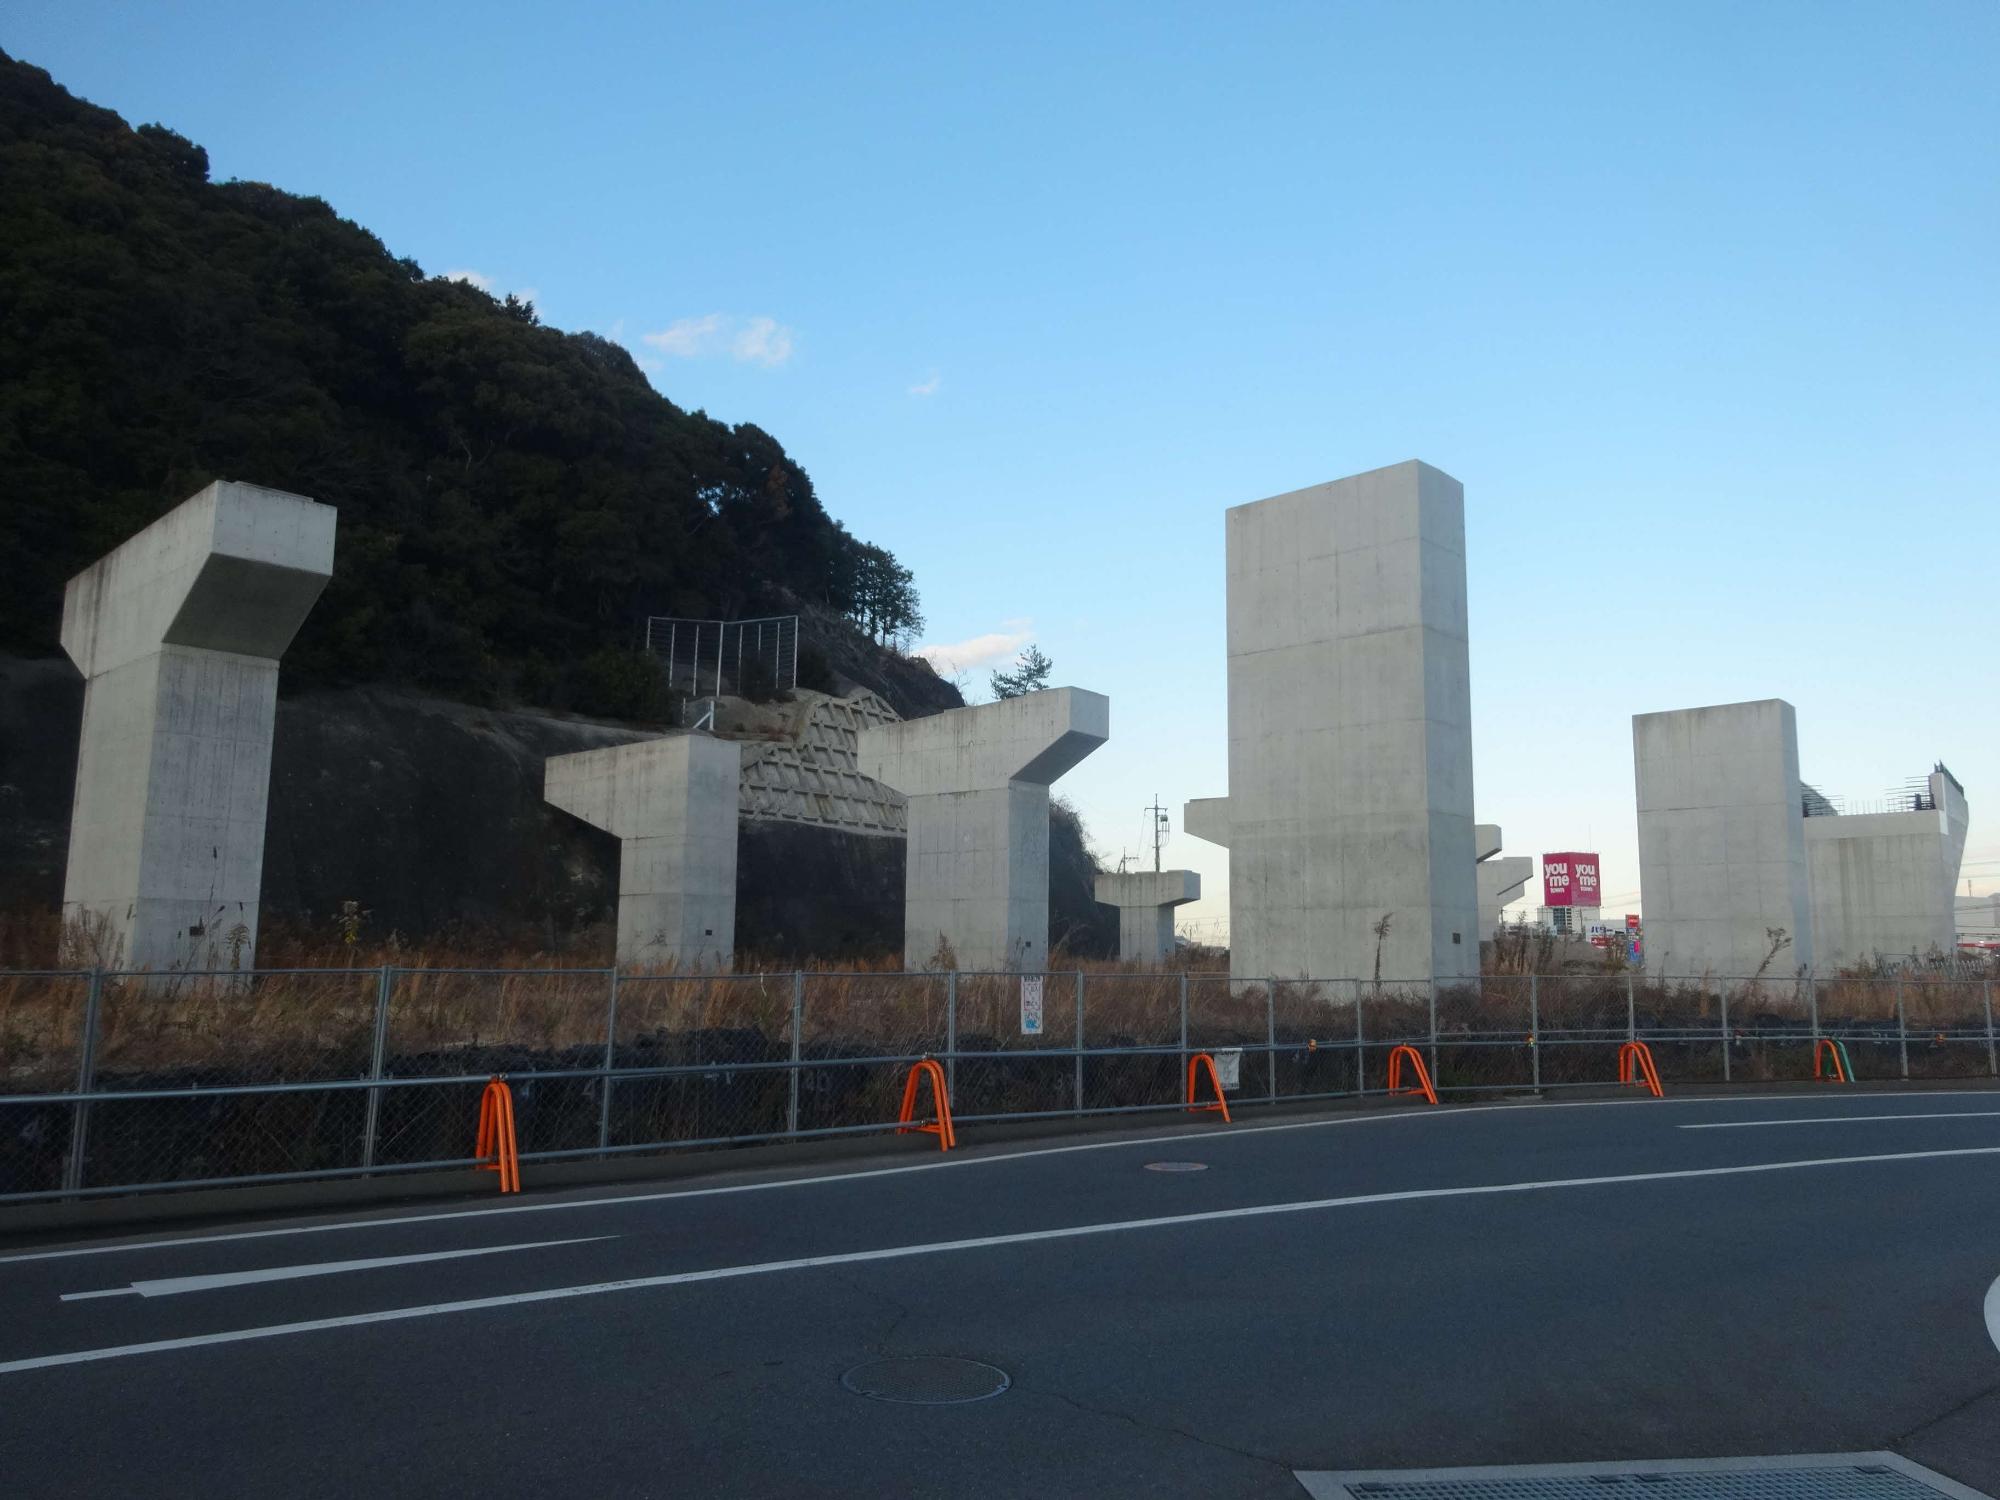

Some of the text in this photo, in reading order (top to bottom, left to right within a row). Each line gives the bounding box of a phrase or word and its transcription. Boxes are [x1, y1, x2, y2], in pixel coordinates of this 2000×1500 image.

[1545, 863, 1567, 879] you
[1575, 864, 1595, 879] you
[1550, 875, 1569, 886] me
[1580, 876, 1597, 886] me
